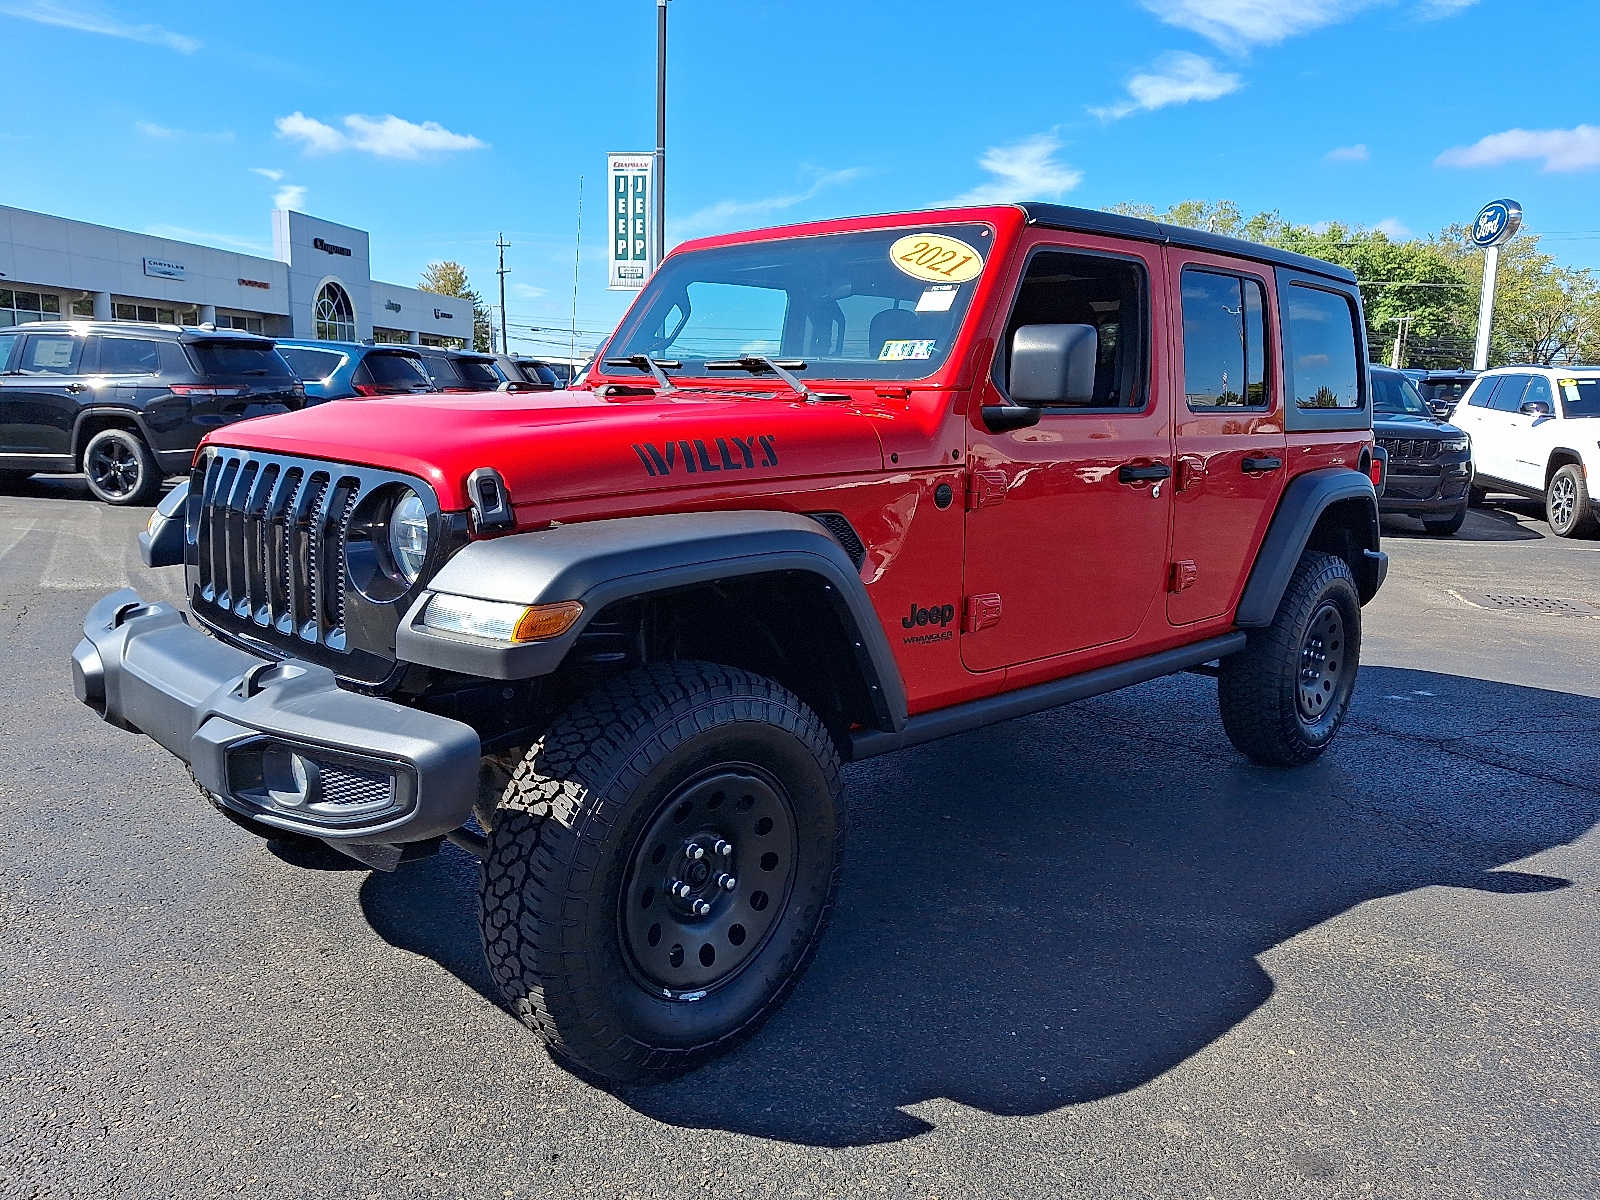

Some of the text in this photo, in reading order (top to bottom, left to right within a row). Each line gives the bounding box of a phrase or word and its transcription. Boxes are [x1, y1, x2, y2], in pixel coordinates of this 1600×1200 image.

[617, 177, 627, 255] JEEP
[635, 177, 645, 255] JEEP
[1476, 209, 1500, 239] Ford
[899, 242, 973, 276] 2021
[631, 435, 778, 476] WILLYS
[902, 603, 954, 628] Jeep
[903, 630, 953, 643] WRANGLER
